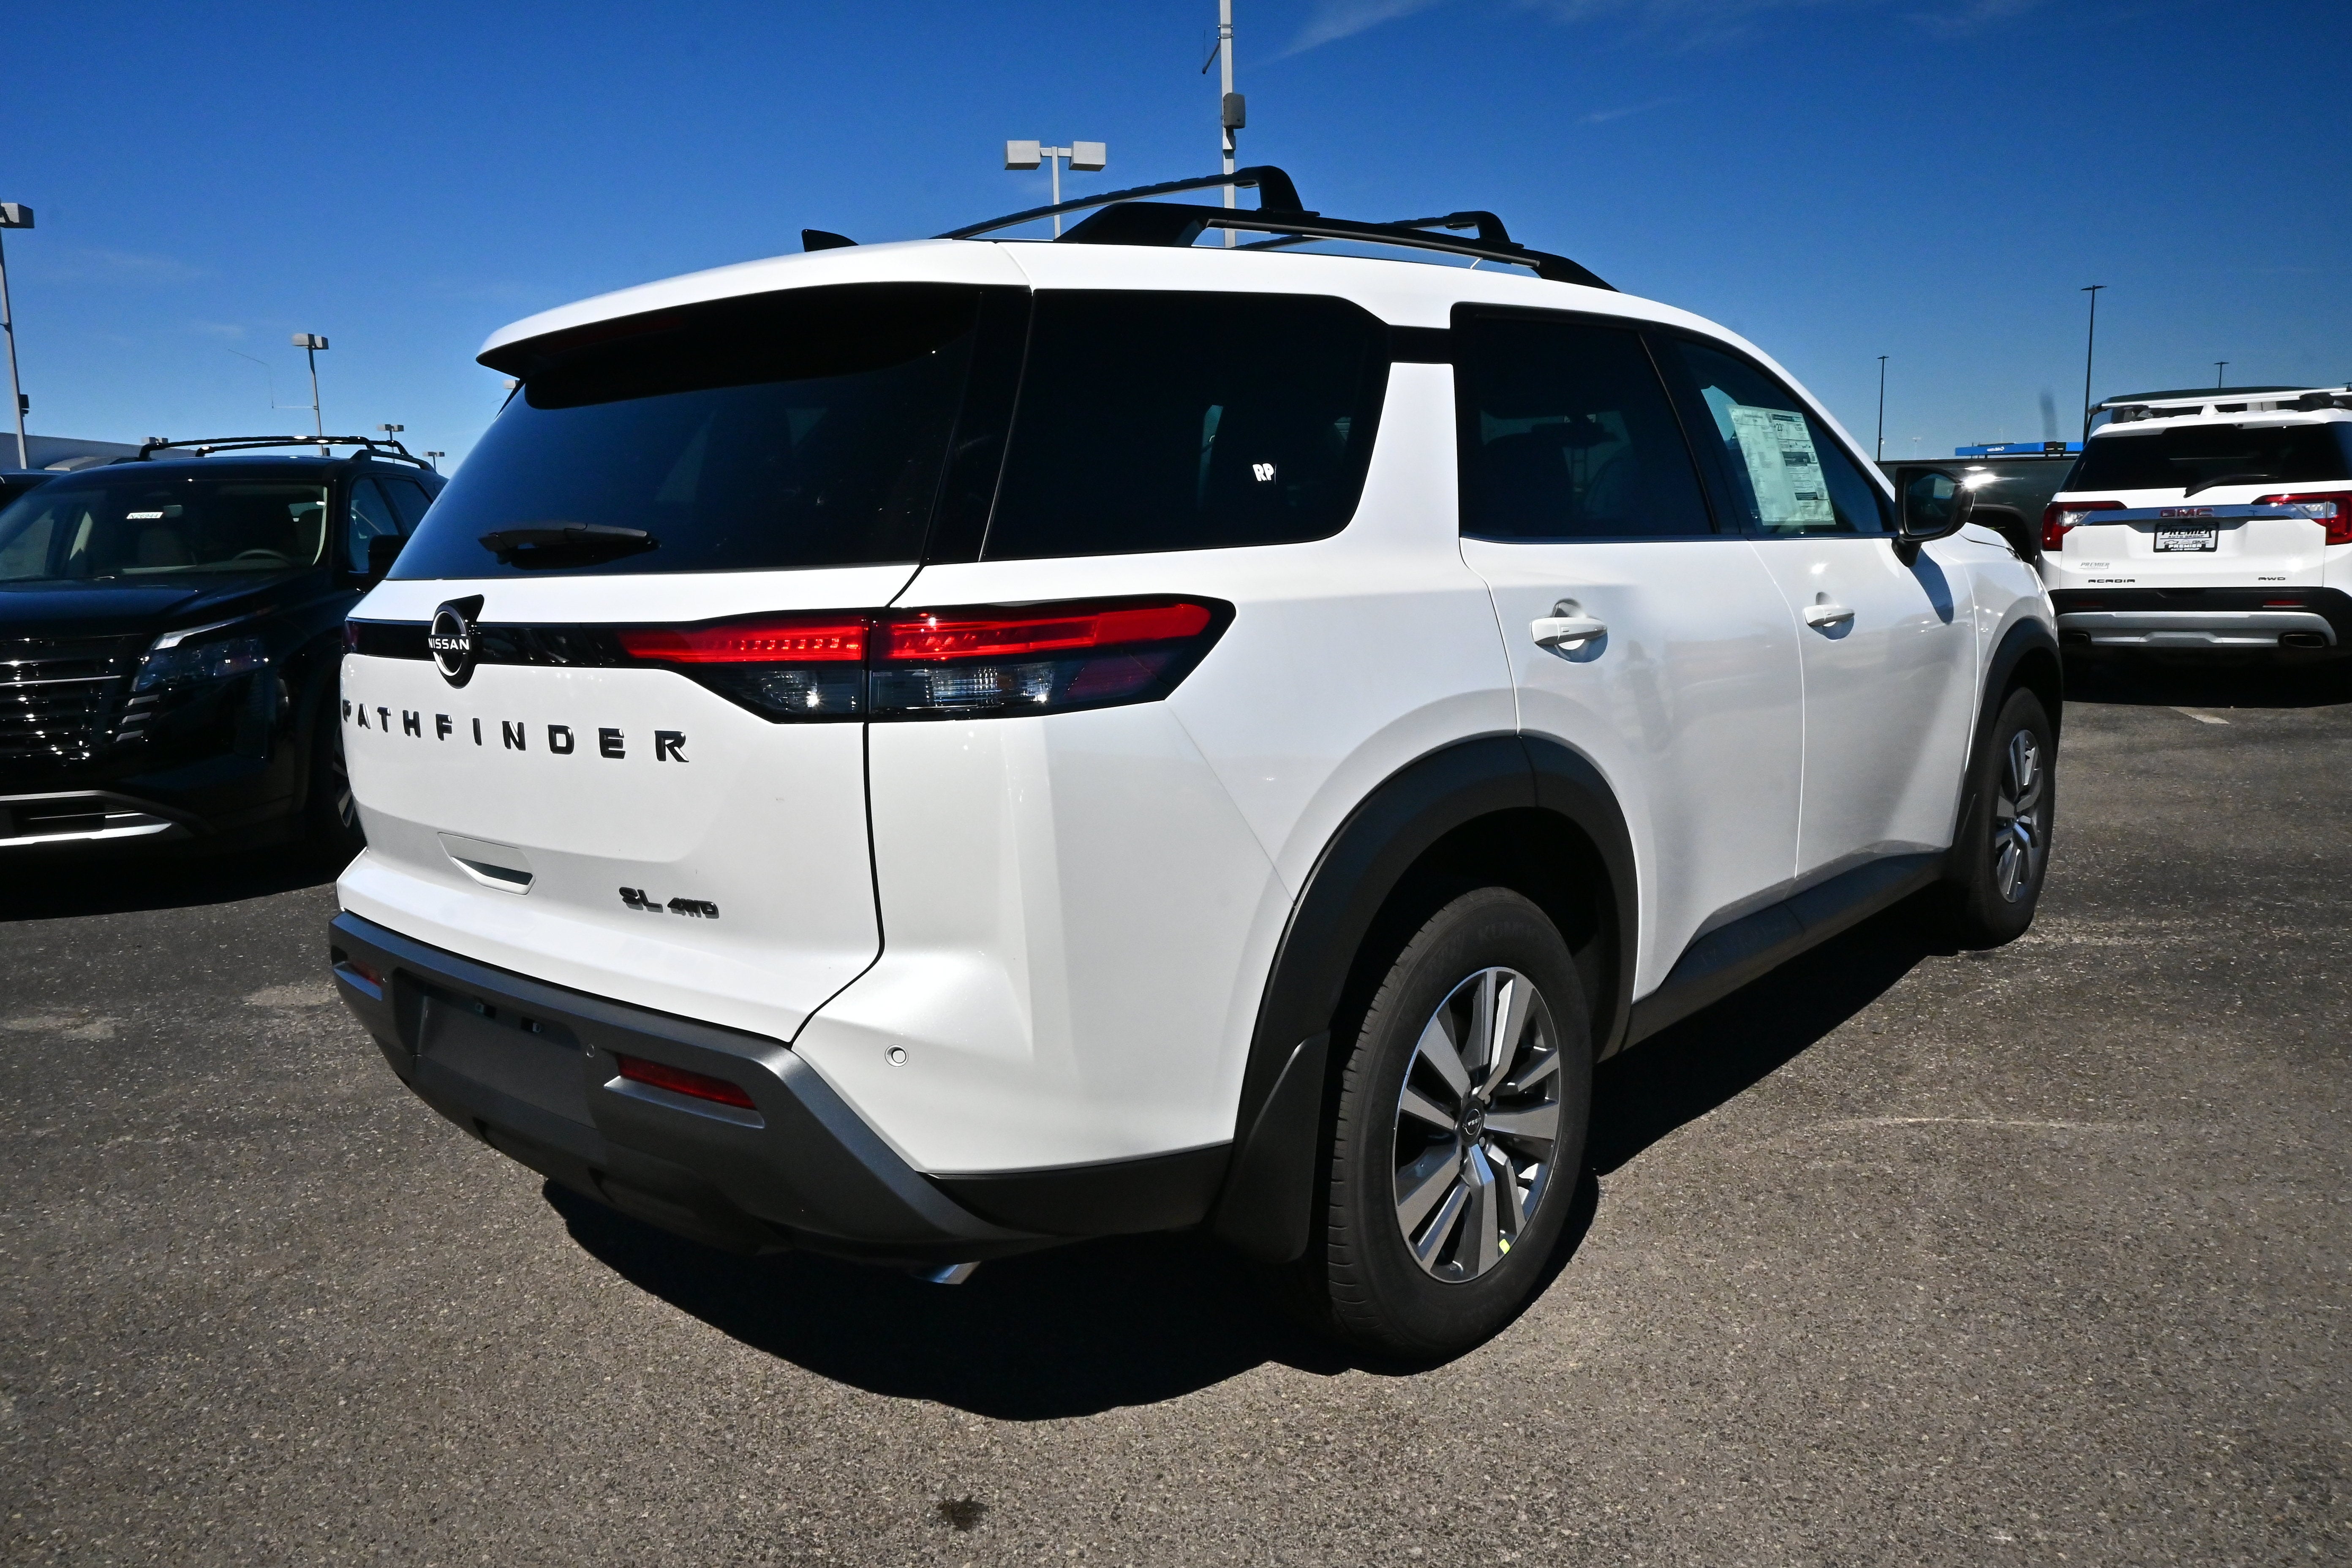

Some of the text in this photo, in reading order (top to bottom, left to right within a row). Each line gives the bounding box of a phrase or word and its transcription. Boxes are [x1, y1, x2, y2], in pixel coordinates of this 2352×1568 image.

[1252, 463, 1274, 482] RP
[2161, 508, 2214, 518] GMC
[2161, 528, 2212, 536] PREMIER
[428, 637, 470, 650] NISSAN
[342, 699, 690, 763] PATHFINDER
[619, 887, 719, 916] SL 4WD
